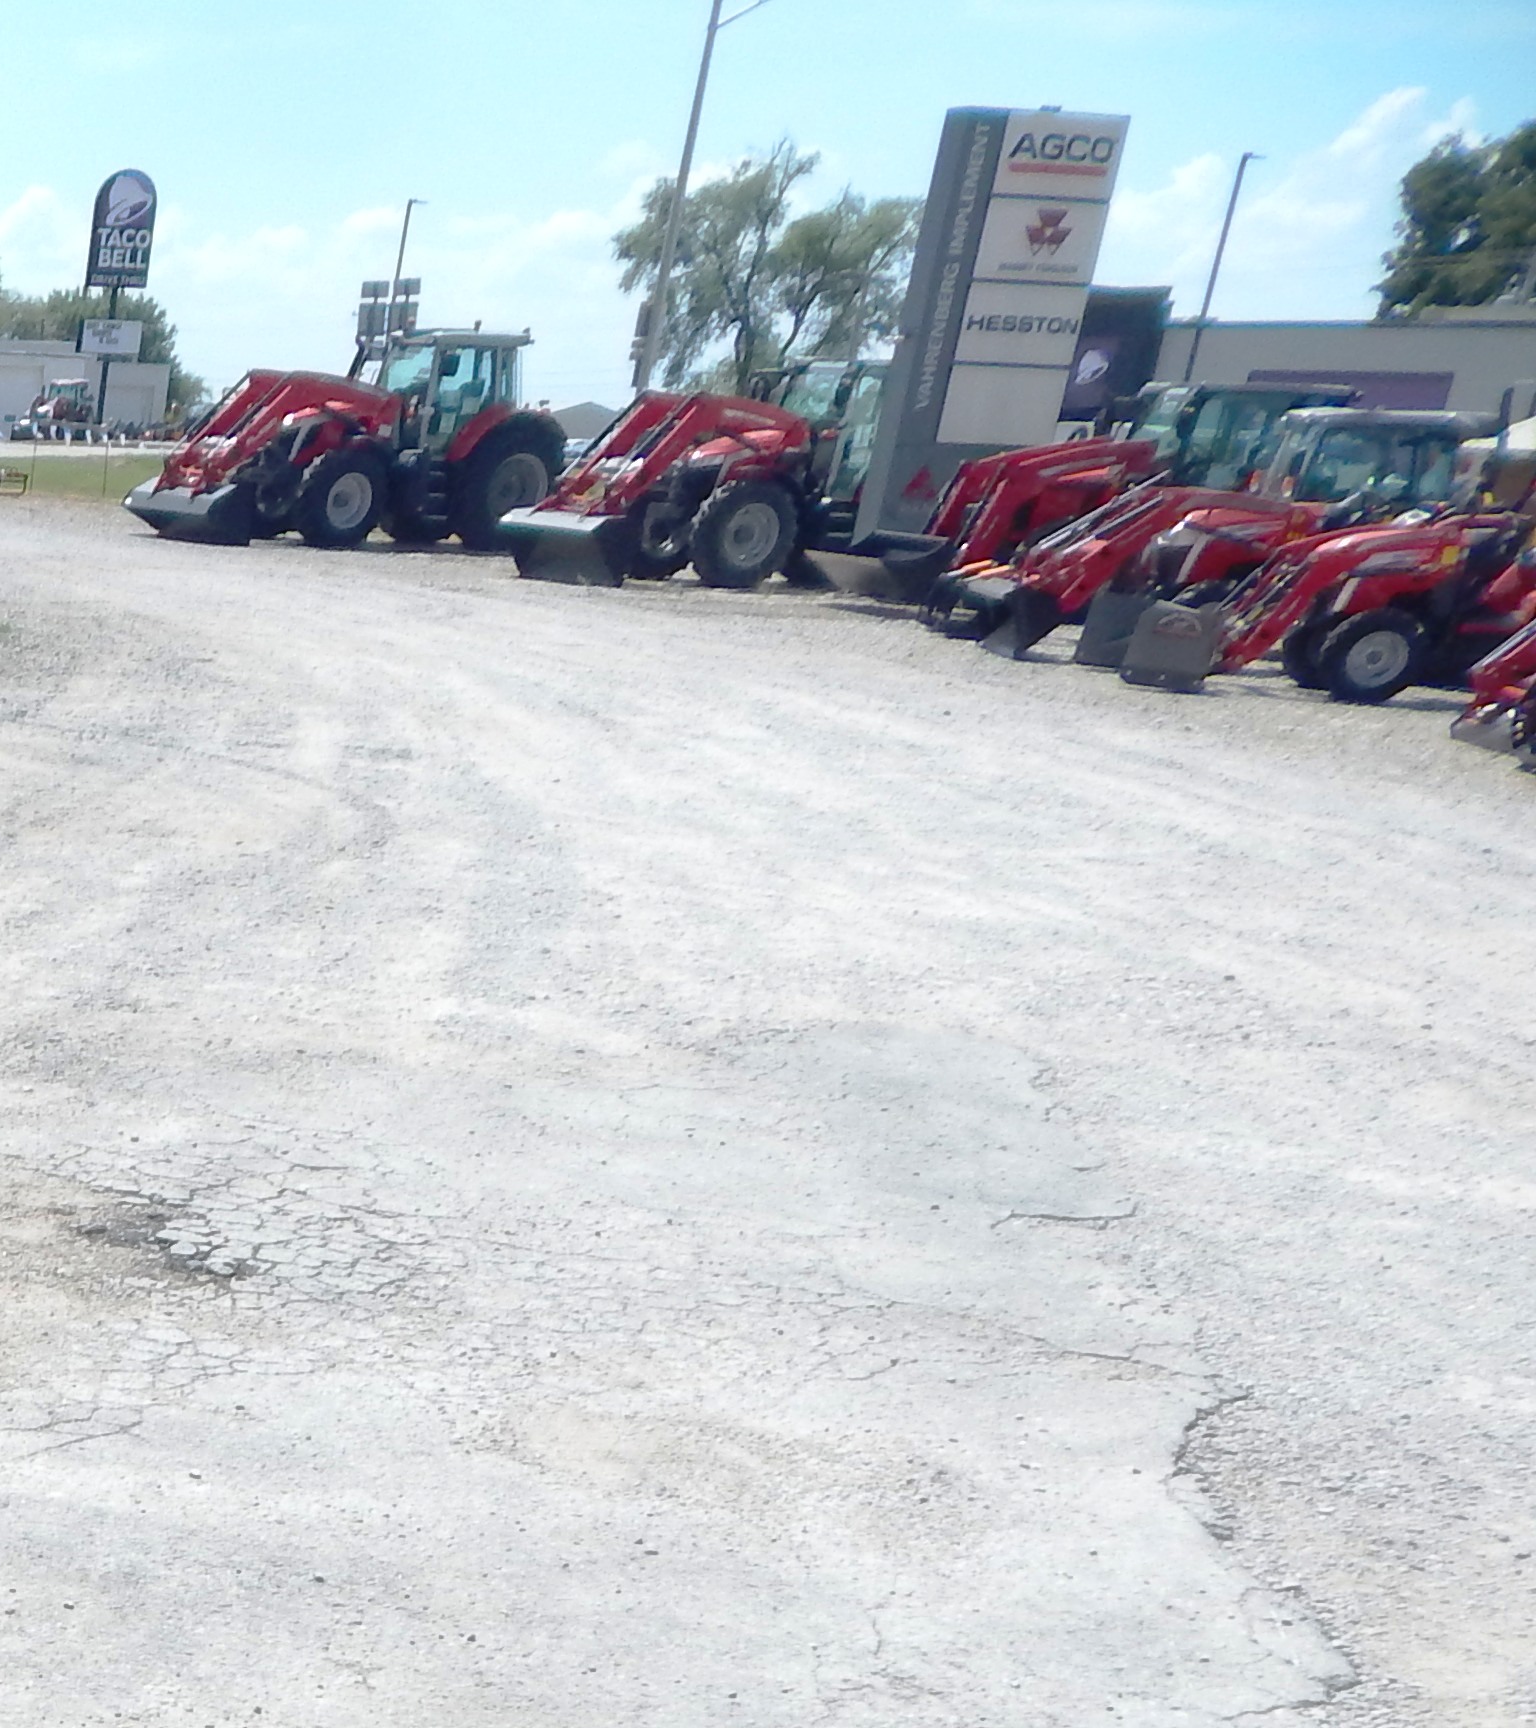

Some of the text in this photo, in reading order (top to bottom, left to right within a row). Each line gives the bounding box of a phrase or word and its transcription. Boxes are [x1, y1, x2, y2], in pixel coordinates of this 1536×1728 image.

[1008, 132, 1115, 165] AGCO
[948, 122, 992, 255] IMPLEMENT
[97, 227, 151, 249] TACO
[97, 248, 146, 269] BELL
[965, 313, 1079, 335] HESSTON
